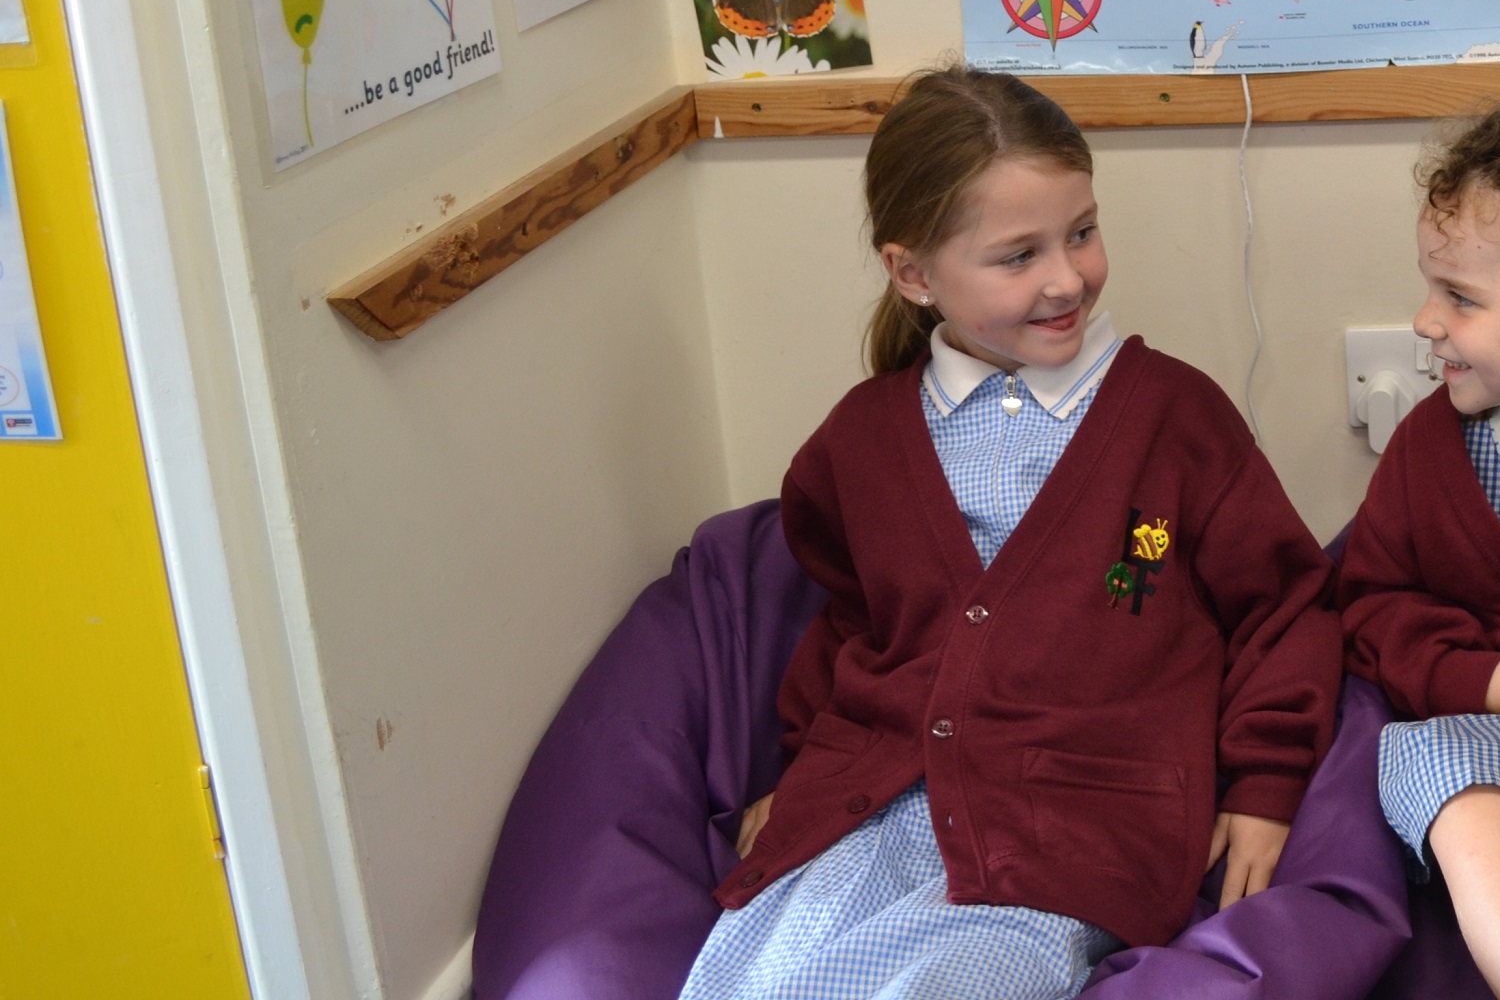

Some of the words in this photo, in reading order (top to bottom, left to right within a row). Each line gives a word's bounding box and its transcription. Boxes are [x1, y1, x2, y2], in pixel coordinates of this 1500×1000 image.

[1352, 22, 1397, 31] SOUTHERN
[1400, 20, 1430, 28] OCEAN
[388, 74, 400, 95] a
[403, 51, 443, 97] good
[446, 29, 497, 80] friend!
